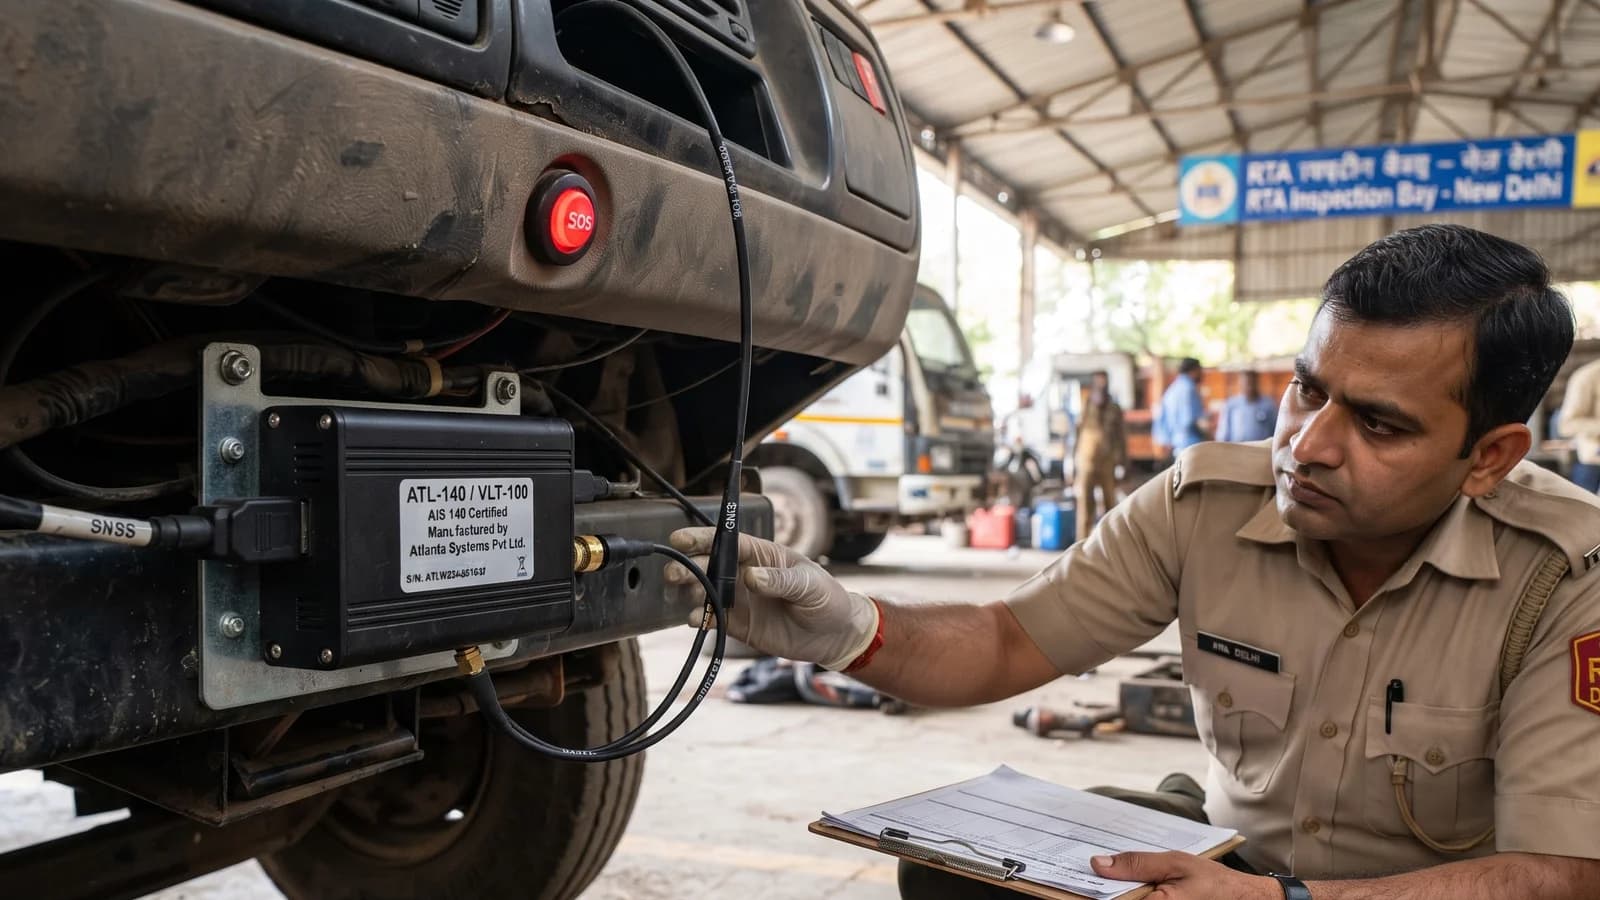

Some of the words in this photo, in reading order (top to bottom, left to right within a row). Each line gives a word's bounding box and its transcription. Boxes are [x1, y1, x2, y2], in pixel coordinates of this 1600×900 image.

[1246, 160, 1293, 187] RTA
[1245, 188, 1288, 214] RTA
[1289, 184, 1394, 216] Inspection
[1396, 180, 1438, 212] Bay
[1453, 176, 1502, 203] New
[1505, 171, 1563, 201] Delhi
[567, 210, 592, 231] SOS
[406, 485, 466, 504] ATL-140
[478, 484, 528, 501] VLT-100
[428, 508, 446, 521] AIS
[449, 507, 466, 520] 140
[468, 506, 508, 519] Certified
[91, 519, 135, 538] SNSS
[497, 522, 508, 536] by
[409, 543, 446, 557] Atlanta
[449, 541, 490, 556] Systems
[492, 539, 507, 551] Pvt
[509, 537, 526, 549] Ltd.
